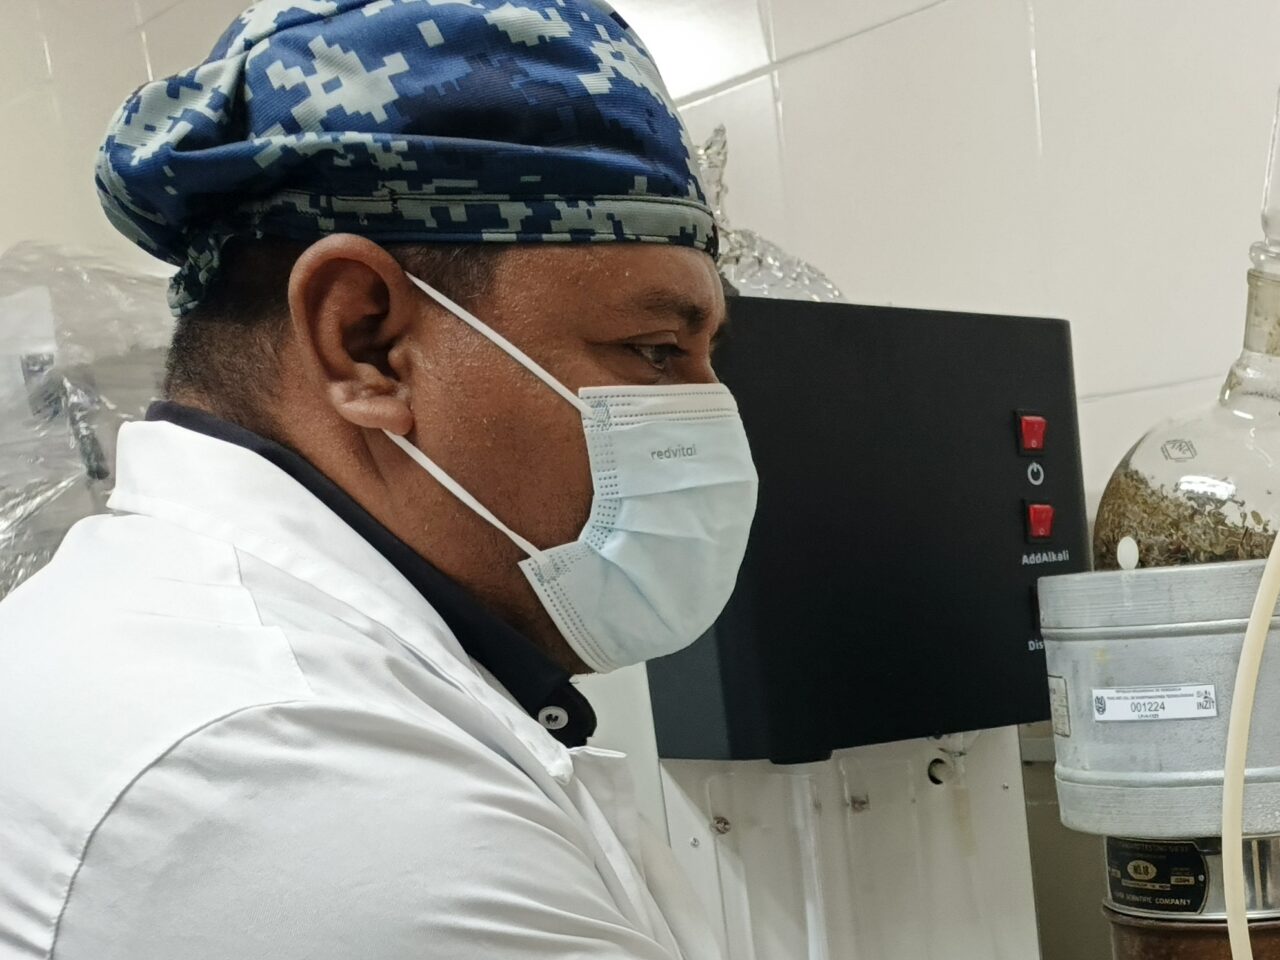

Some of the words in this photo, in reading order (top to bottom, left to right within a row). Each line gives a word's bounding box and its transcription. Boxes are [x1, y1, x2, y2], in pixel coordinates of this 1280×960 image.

[651, 443, 697, 460] redvital
[1022, 550, 1070, 565] AddAlkali
[1130, 701, 1166, 713] 001224
